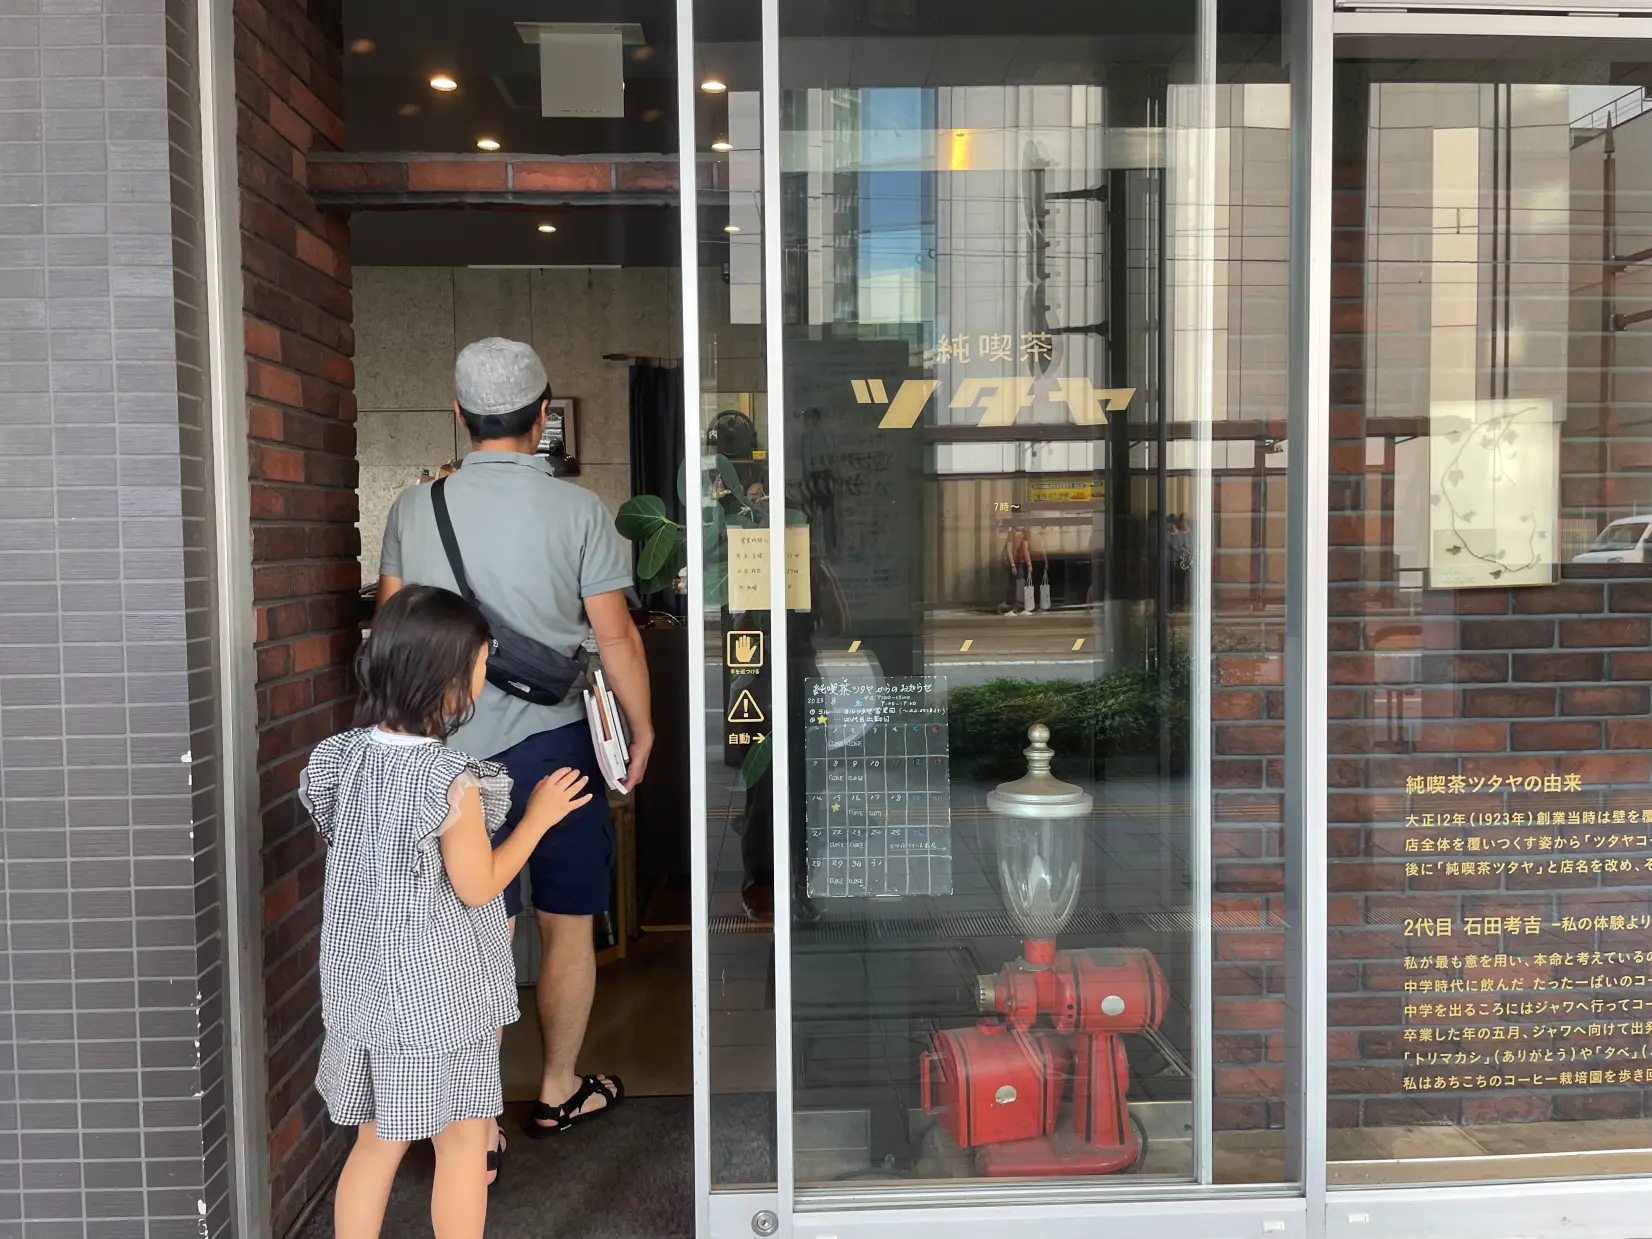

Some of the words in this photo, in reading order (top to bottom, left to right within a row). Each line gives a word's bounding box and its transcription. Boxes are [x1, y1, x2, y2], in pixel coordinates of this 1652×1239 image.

[936, 332, 1052, 364] 純喫茶
[851, 377, 1137, 428] ツタヤ
[728, 732, 750, 745] 自動
[1406, 773, 1582, 795] 純喫茶ツタヤの由来
[1405, 834, 1652, 852] 店全体を覆いつくす姿から「ツタヤコ
[1404, 918, 1452, 936] 2代目
[1464, 916, 1542, 936] 石田考吉
[1404, 978, 1524, 994] 中学時代に飲んだ
[1404, 1044, 1652, 1065] 「トリマカシ」(ありがとう)や「タベ」(
